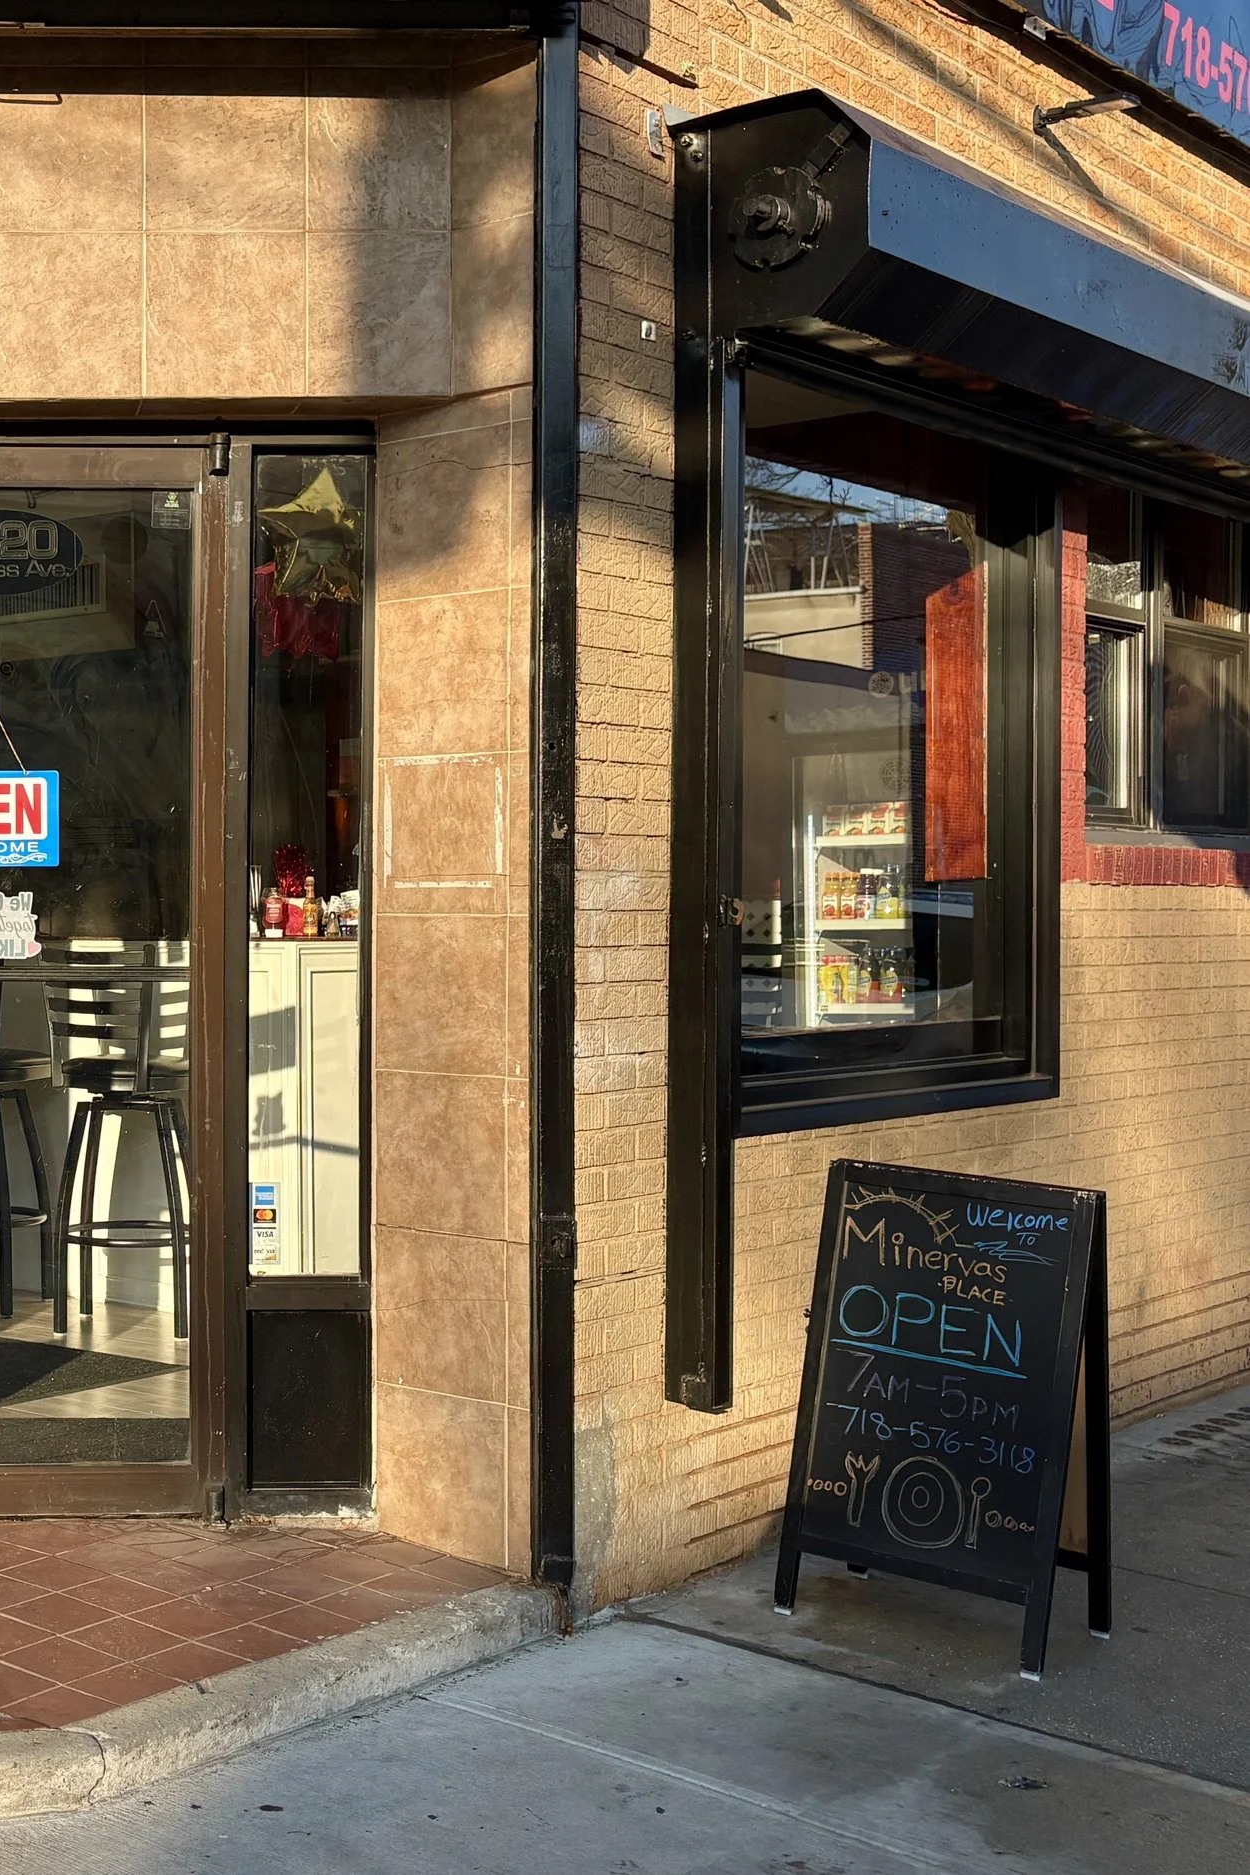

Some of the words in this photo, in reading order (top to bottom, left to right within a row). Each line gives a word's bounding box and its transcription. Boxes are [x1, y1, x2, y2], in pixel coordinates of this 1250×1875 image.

[1164, 1, 1250, 115] 718-57
[25, 560, 71, 578] Ave.
[256, 1230, 274, 1238] VISA
[840, 1284, 1023, 1368] OPEN
[826, 1402, 1036, 1474] 718-576-3118
